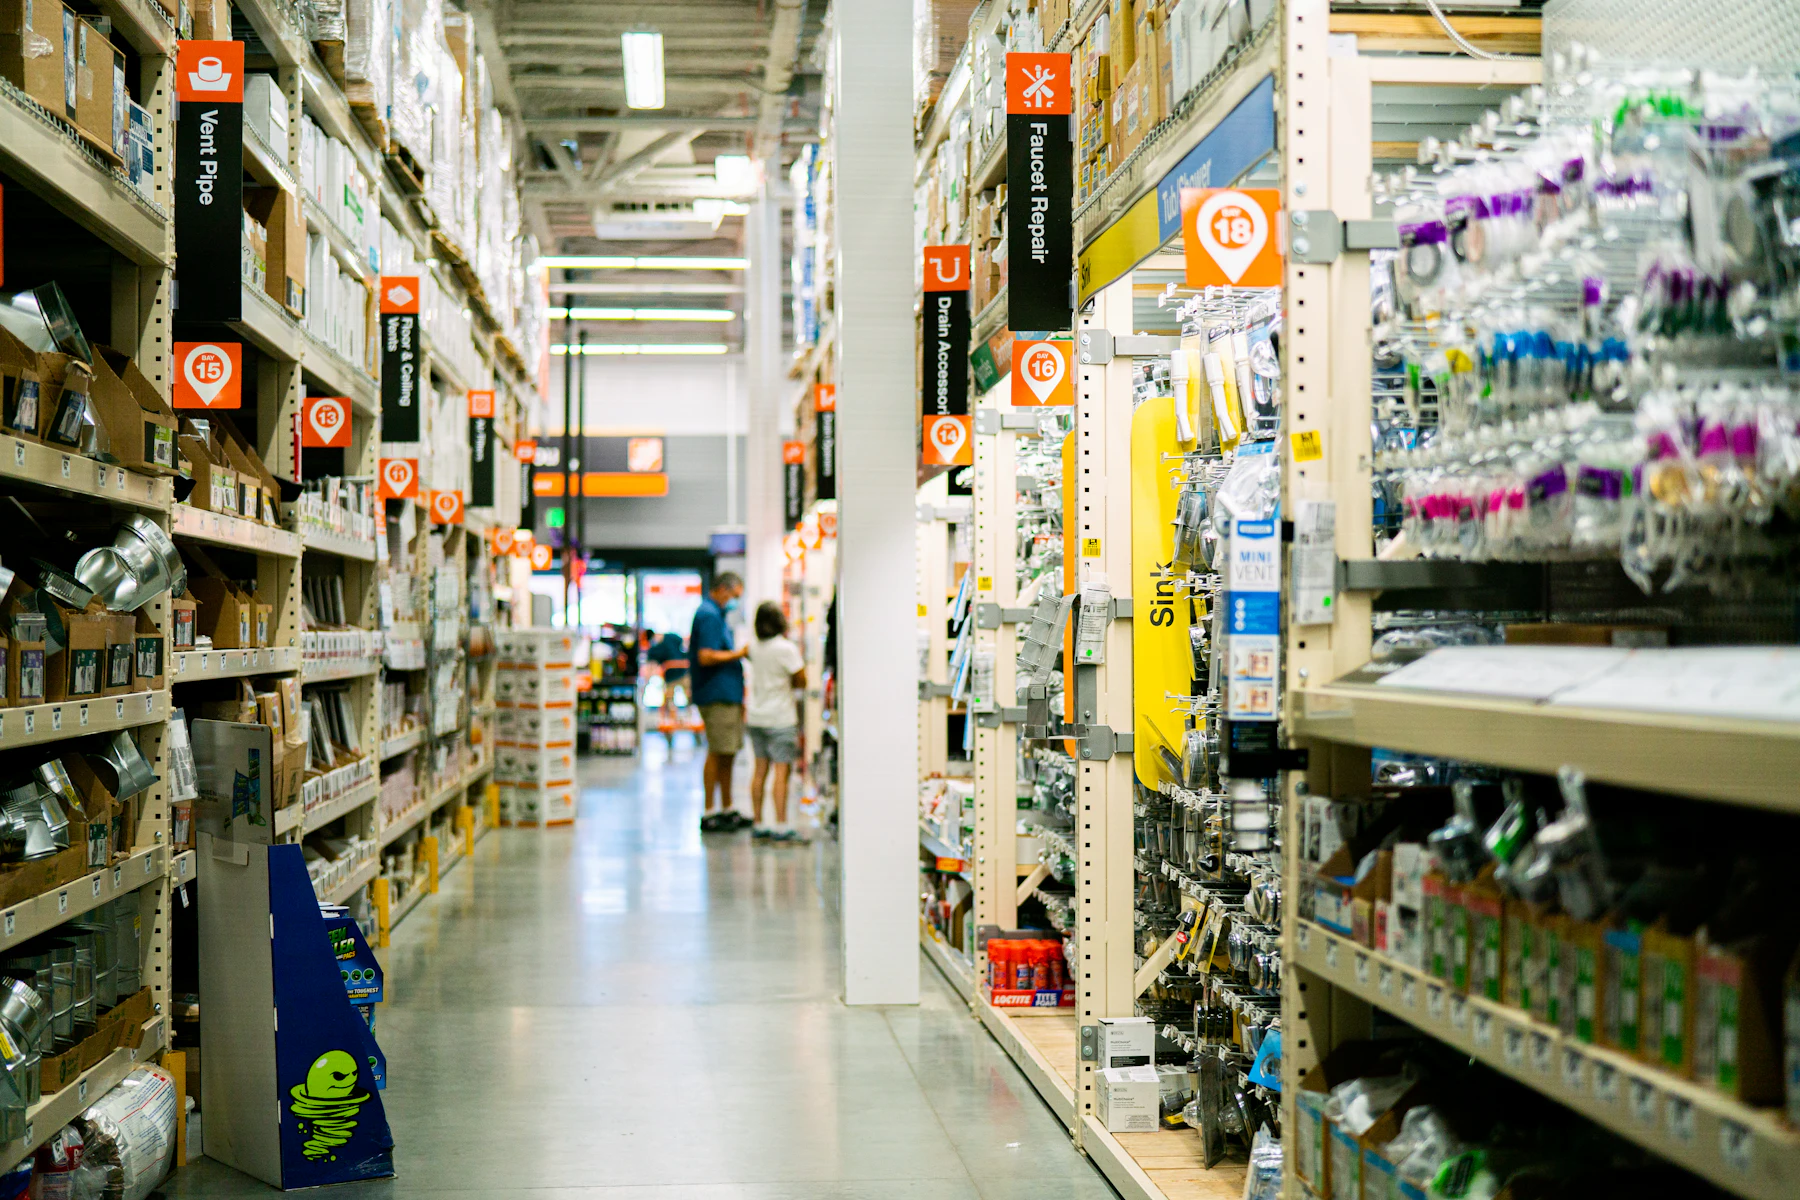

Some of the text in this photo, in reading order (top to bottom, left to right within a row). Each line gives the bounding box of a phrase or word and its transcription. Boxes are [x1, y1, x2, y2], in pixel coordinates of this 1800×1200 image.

[196, 110, 218, 206] Vent Pipe
[1028, 123, 1049, 264] Faucet Repair
[1214, 218, 1252, 245] 18
[1081, 261, 1092, 291] Sink
[387, 316, 399, 352] Vents
[398, 317, 413, 407] Floor & Ceiling
[937, 297, 951, 415] Drain Accessori
[196, 362, 221, 379] 15
[1031, 360, 1055, 377] 16
[318, 412, 337, 425] 13
[939, 430, 957, 443] 14
[391, 469, 405, 481] 11
[1240, 552, 1271, 563] MINI
[1235, 564, 1276, 580] VENT
[1150, 561, 1174, 627] Sink
[993, 995, 1031, 1005] LOCTITE
